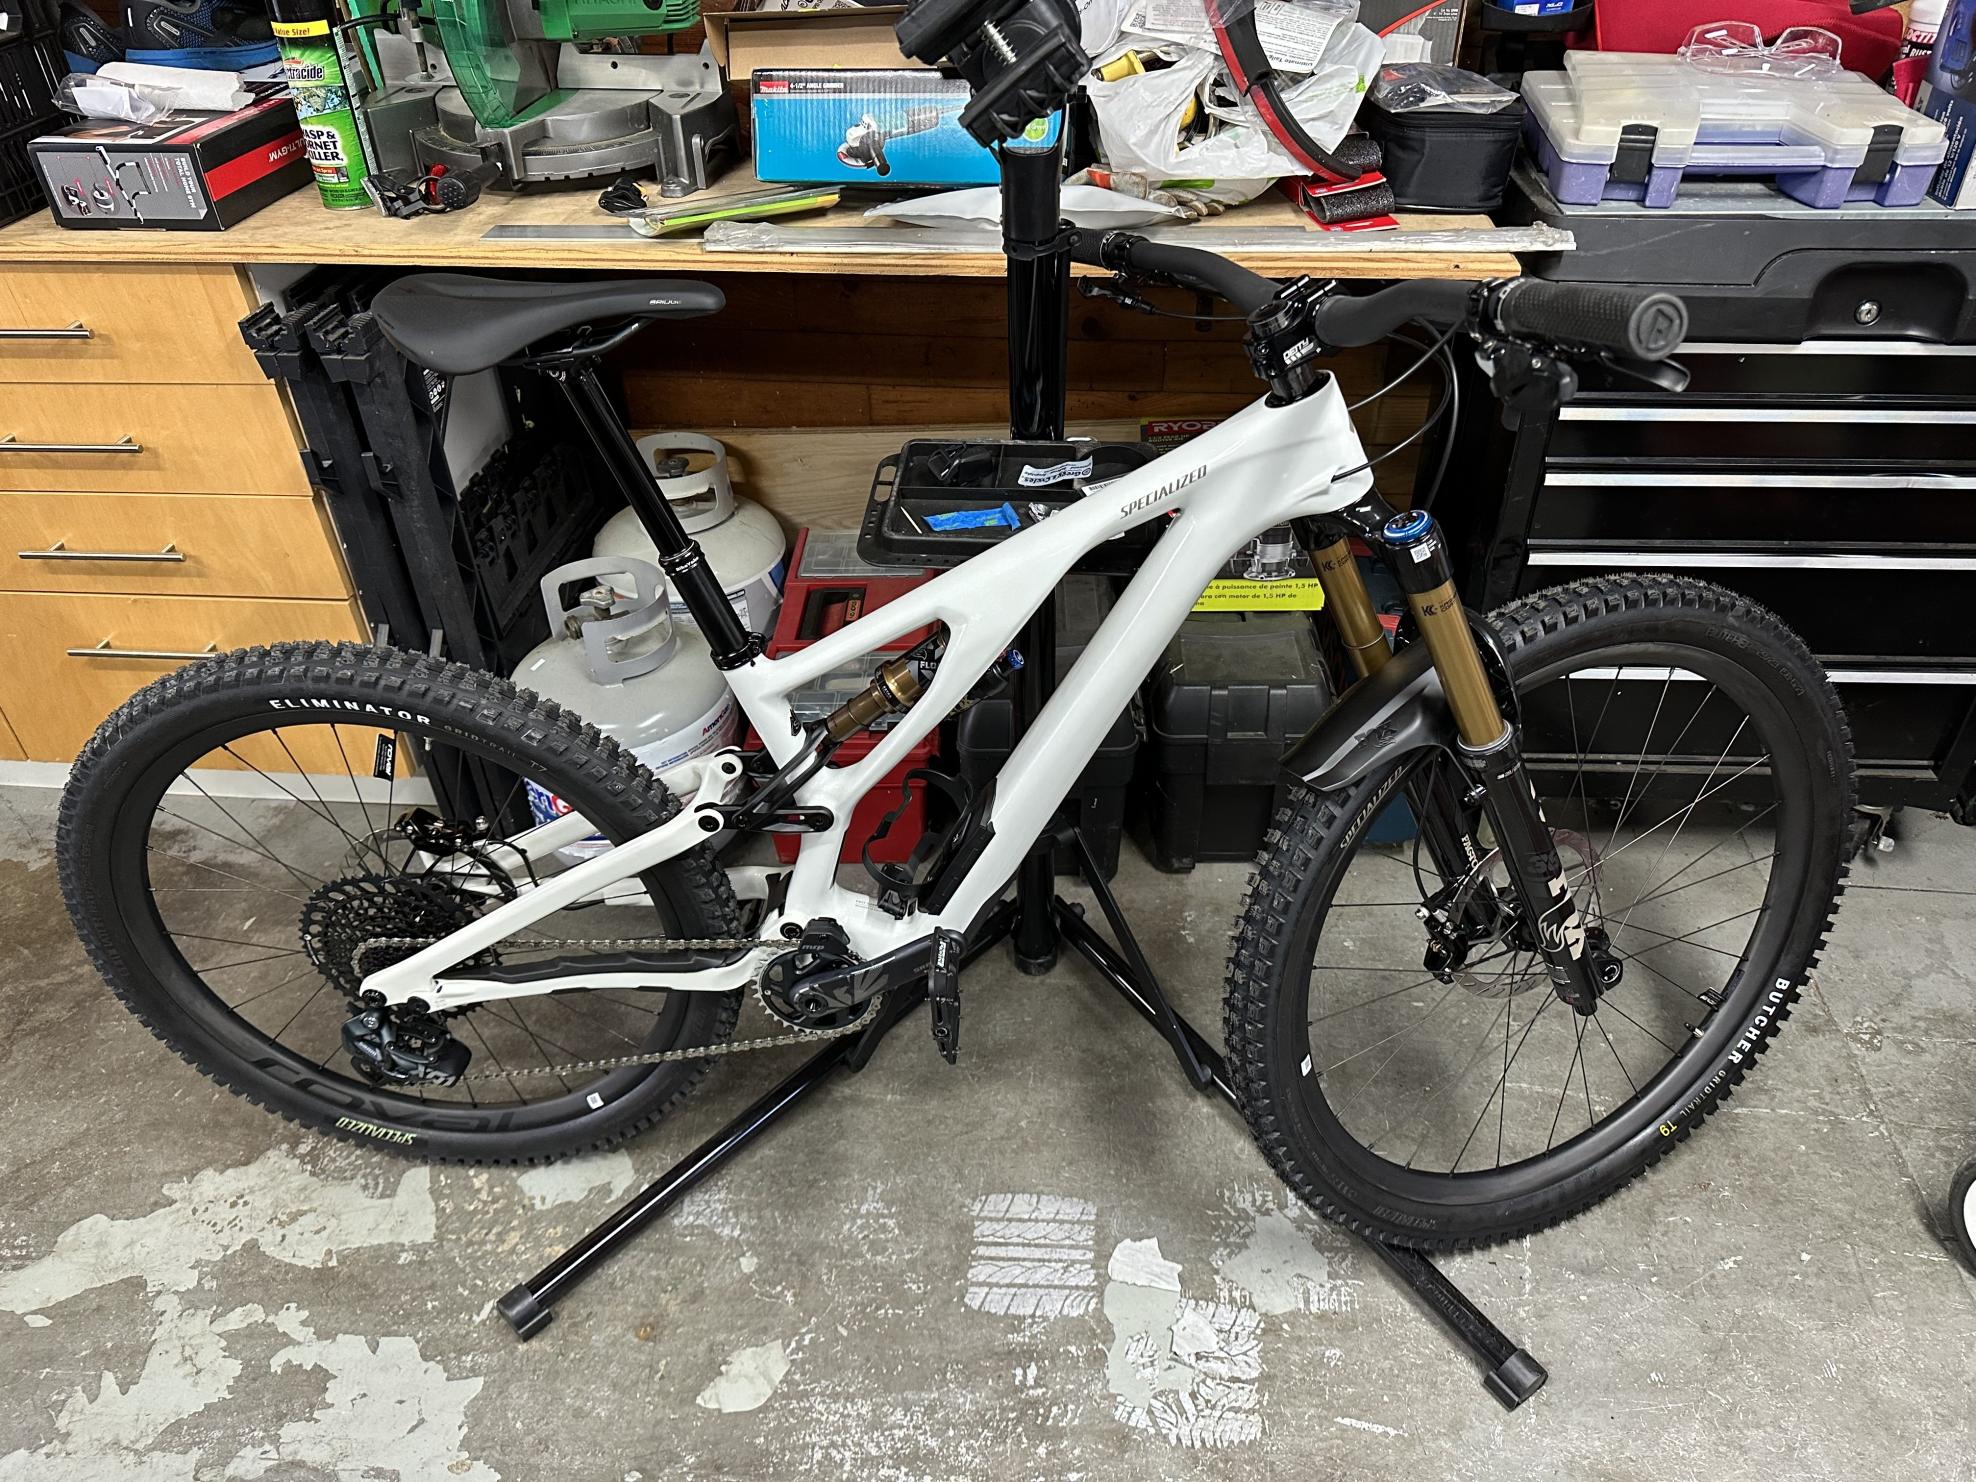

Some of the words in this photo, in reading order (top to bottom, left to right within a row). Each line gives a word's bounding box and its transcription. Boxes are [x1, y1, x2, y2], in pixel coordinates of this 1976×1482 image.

[1905, 27, 1938, 44] LOCTIT
[302, 129, 324, 140] ASP
[326, 130, 336, 140] &
[268, 138, 307, 163] ULTI-GYM
[1152, 421, 1219, 433] RYOB
[1120, 464, 1207, 519] SPECIALIZED
[1251, 591, 1260, 599] de
[1258, 582, 1268, 590] de
[1295, 581, 1306, 590] 1,5
[1307, 581, 1319, 589] HP
[919, 660, 937, 669] FLO
[269, 698, 431, 726] ELIMINATOR
[1339, 765, 1403, 850] SPECIALIZED
[1461, 833, 1479, 868] FACTO
[1727, 977, 1791, 1064] BUTCHER
[335, 1116, 417, 1146] SPECIALIZED
[1658, 1119, 1678, 1137] T9
